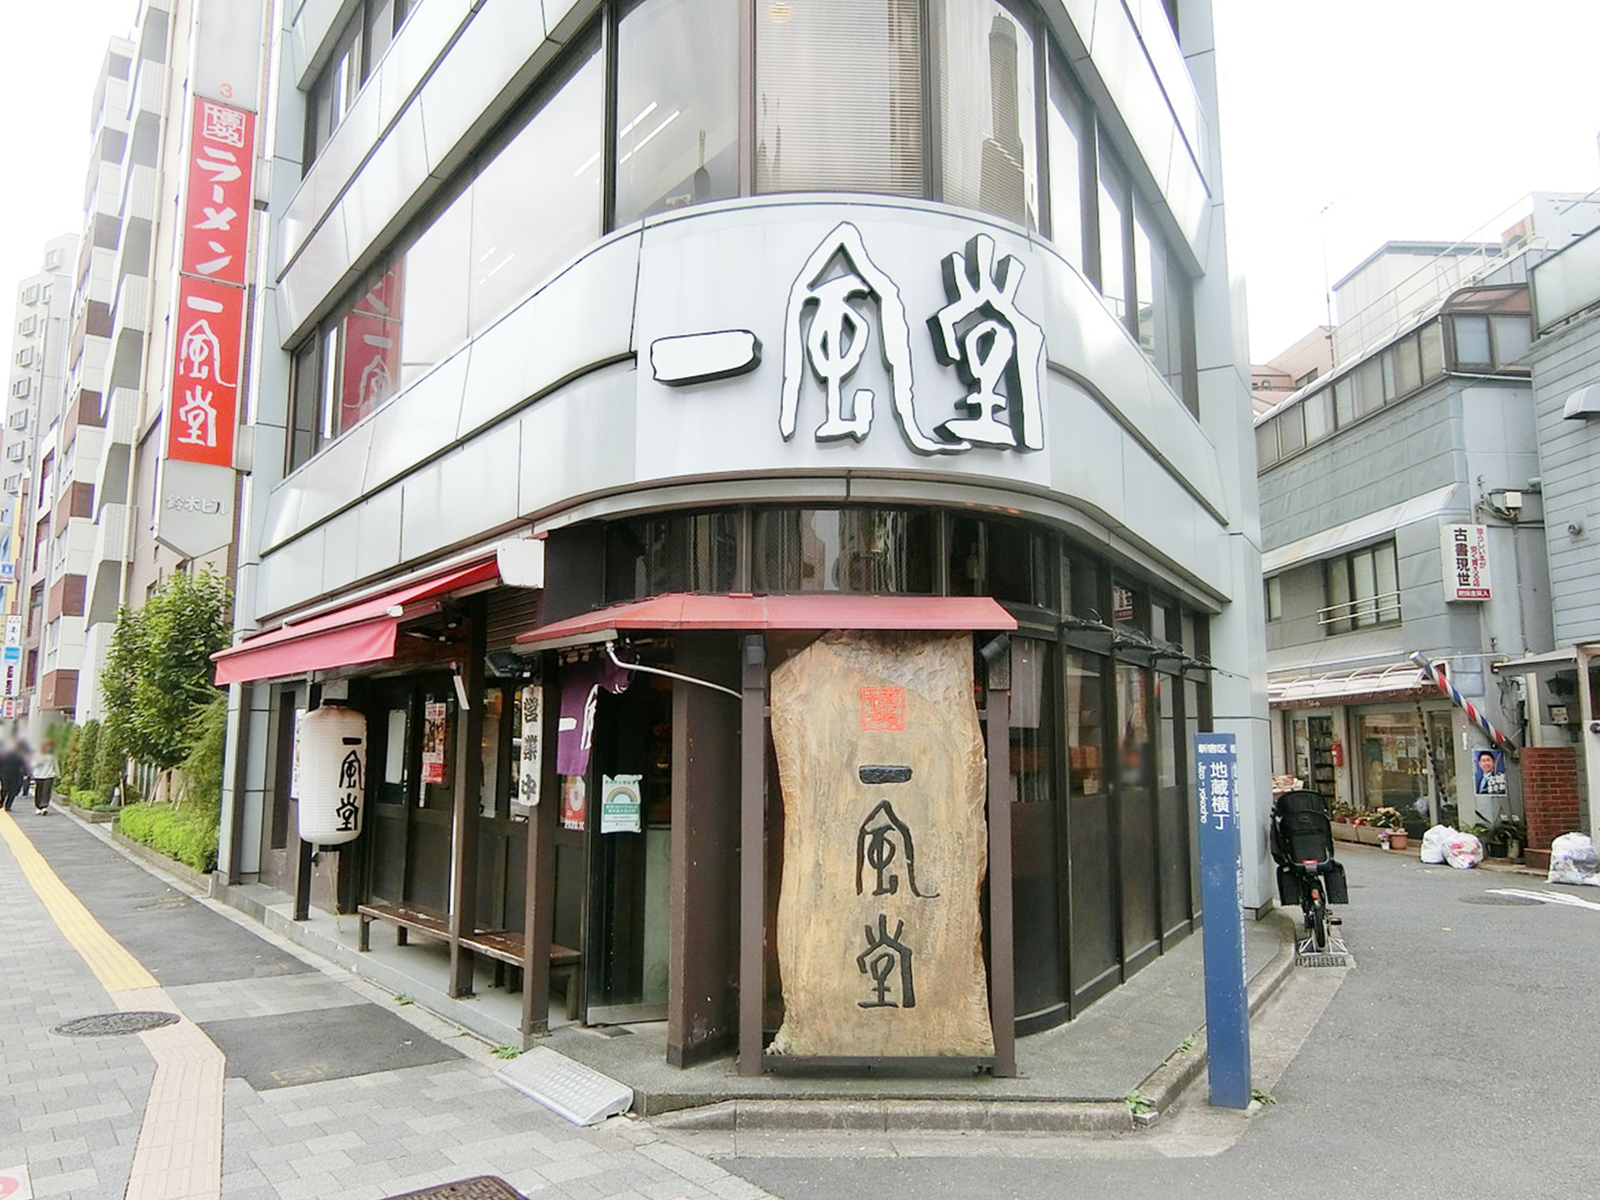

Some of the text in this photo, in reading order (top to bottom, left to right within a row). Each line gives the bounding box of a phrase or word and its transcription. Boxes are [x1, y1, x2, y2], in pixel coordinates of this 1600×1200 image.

[193, 146, 242, 275] ラーメン
[178, 296, 236, 447] 一風堂
[650, 221, 1046, 456] 一風堂
[166, 494, 229, 515] 鈴木ビル
[1453, 527, 1471, 587] 古書現世
[336, 737, 365, 832] 一風堂
[521, 697, 539, 798] 営業中
[1209, 761, 1230, 830] 地蔵横丁
[857, 764, 940, 1008] 一風堂
